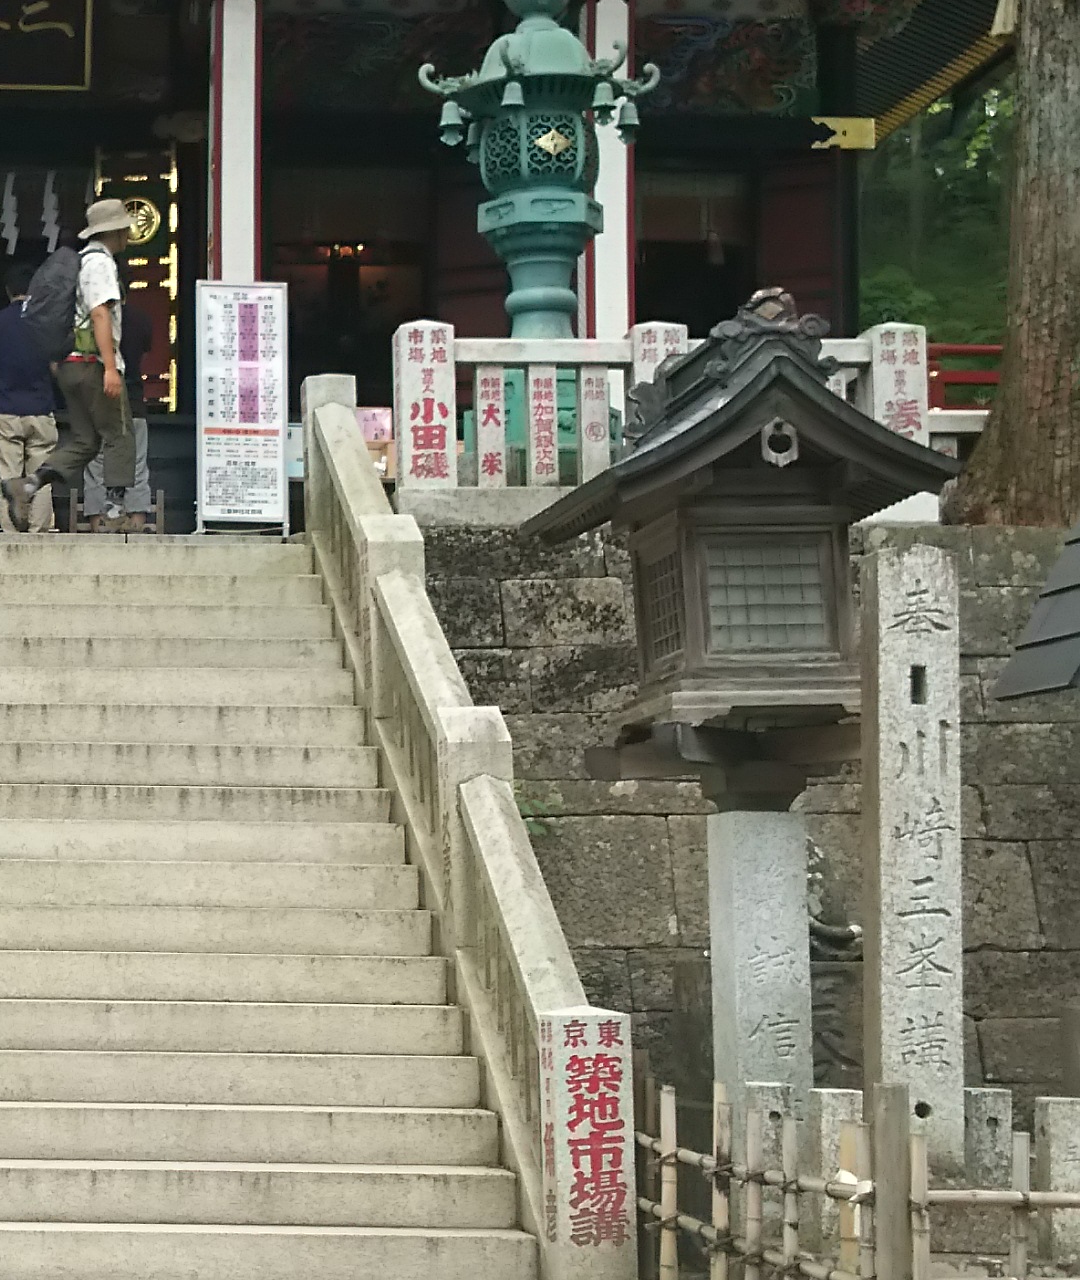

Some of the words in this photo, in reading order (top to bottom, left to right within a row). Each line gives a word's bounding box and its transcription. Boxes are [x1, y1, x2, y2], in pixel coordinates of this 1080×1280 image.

[563, 1019, 624, 1048] 東京
[565, 1053, 632, 1248] 築地市場講
